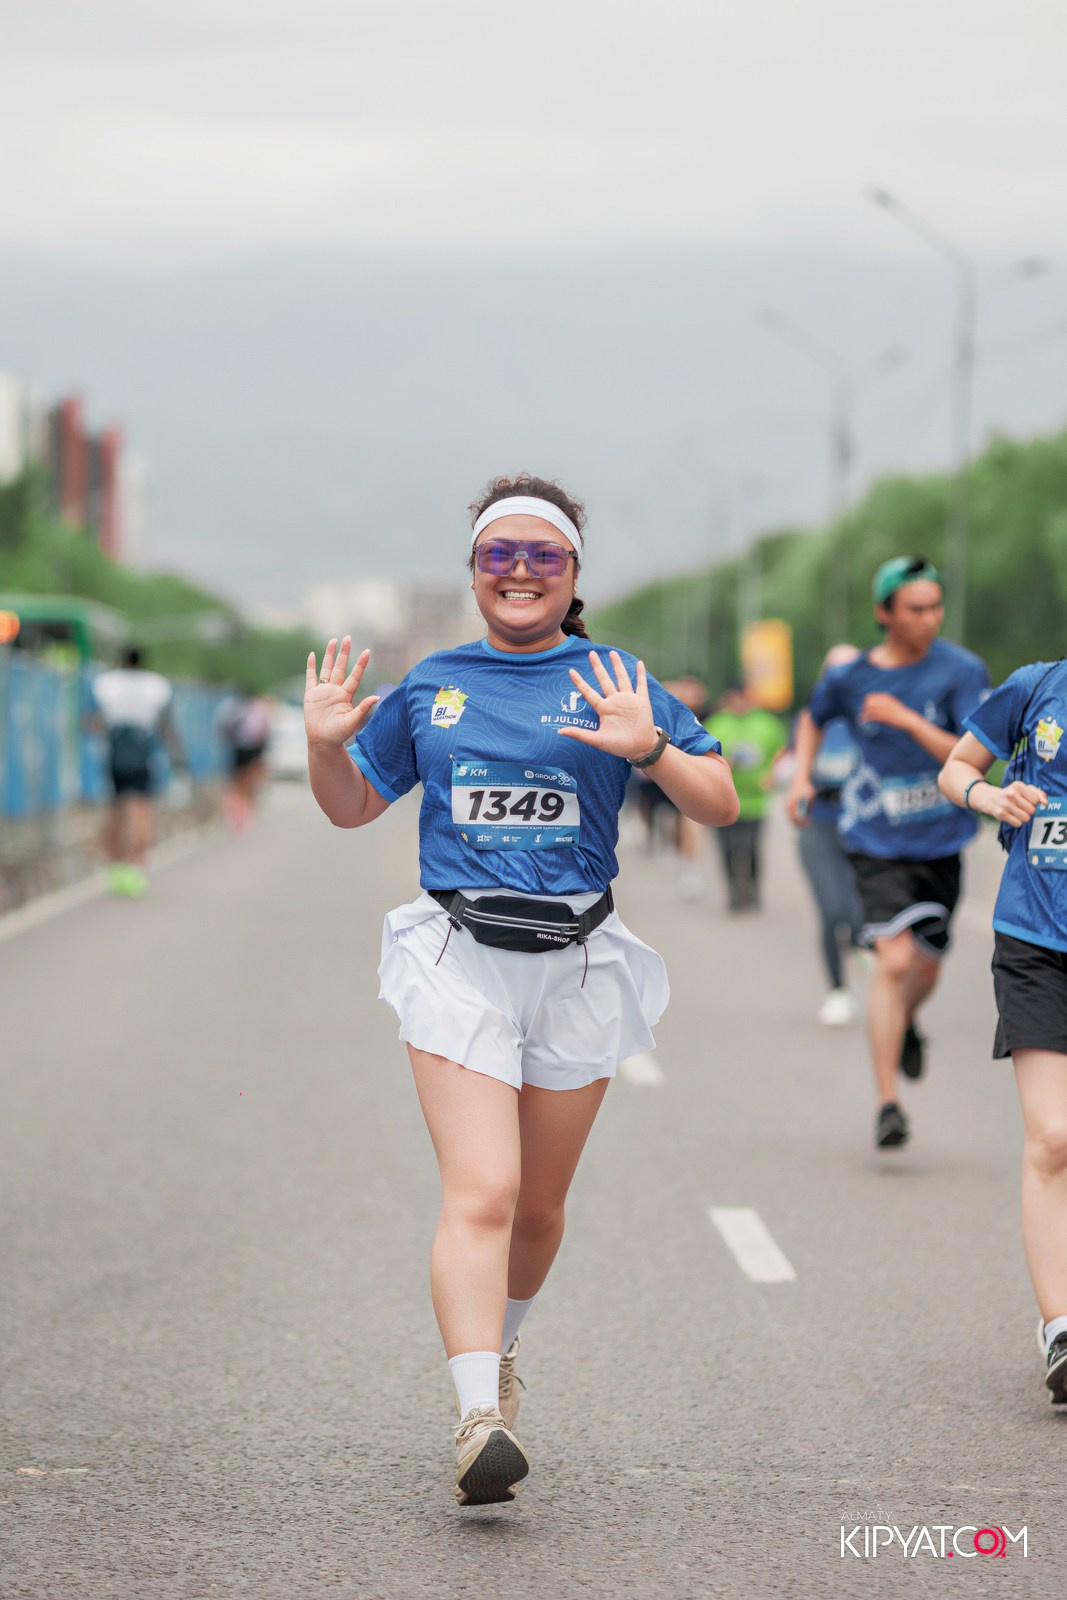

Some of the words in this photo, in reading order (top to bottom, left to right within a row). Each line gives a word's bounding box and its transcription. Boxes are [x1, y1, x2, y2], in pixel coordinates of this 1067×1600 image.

[435, 706, 448, 717] BI
[541, 715, 551, 723] BI
[553, 715, 598, 730] JULDYZAI
[457, 766, 469, 777] 5
[470, 768, 488, 777] KM
[535, 773, 558, 781] GROUP
[468, 790, 565, 822] 1349
[536, 932, 571, 944] RIKA-SHOP
